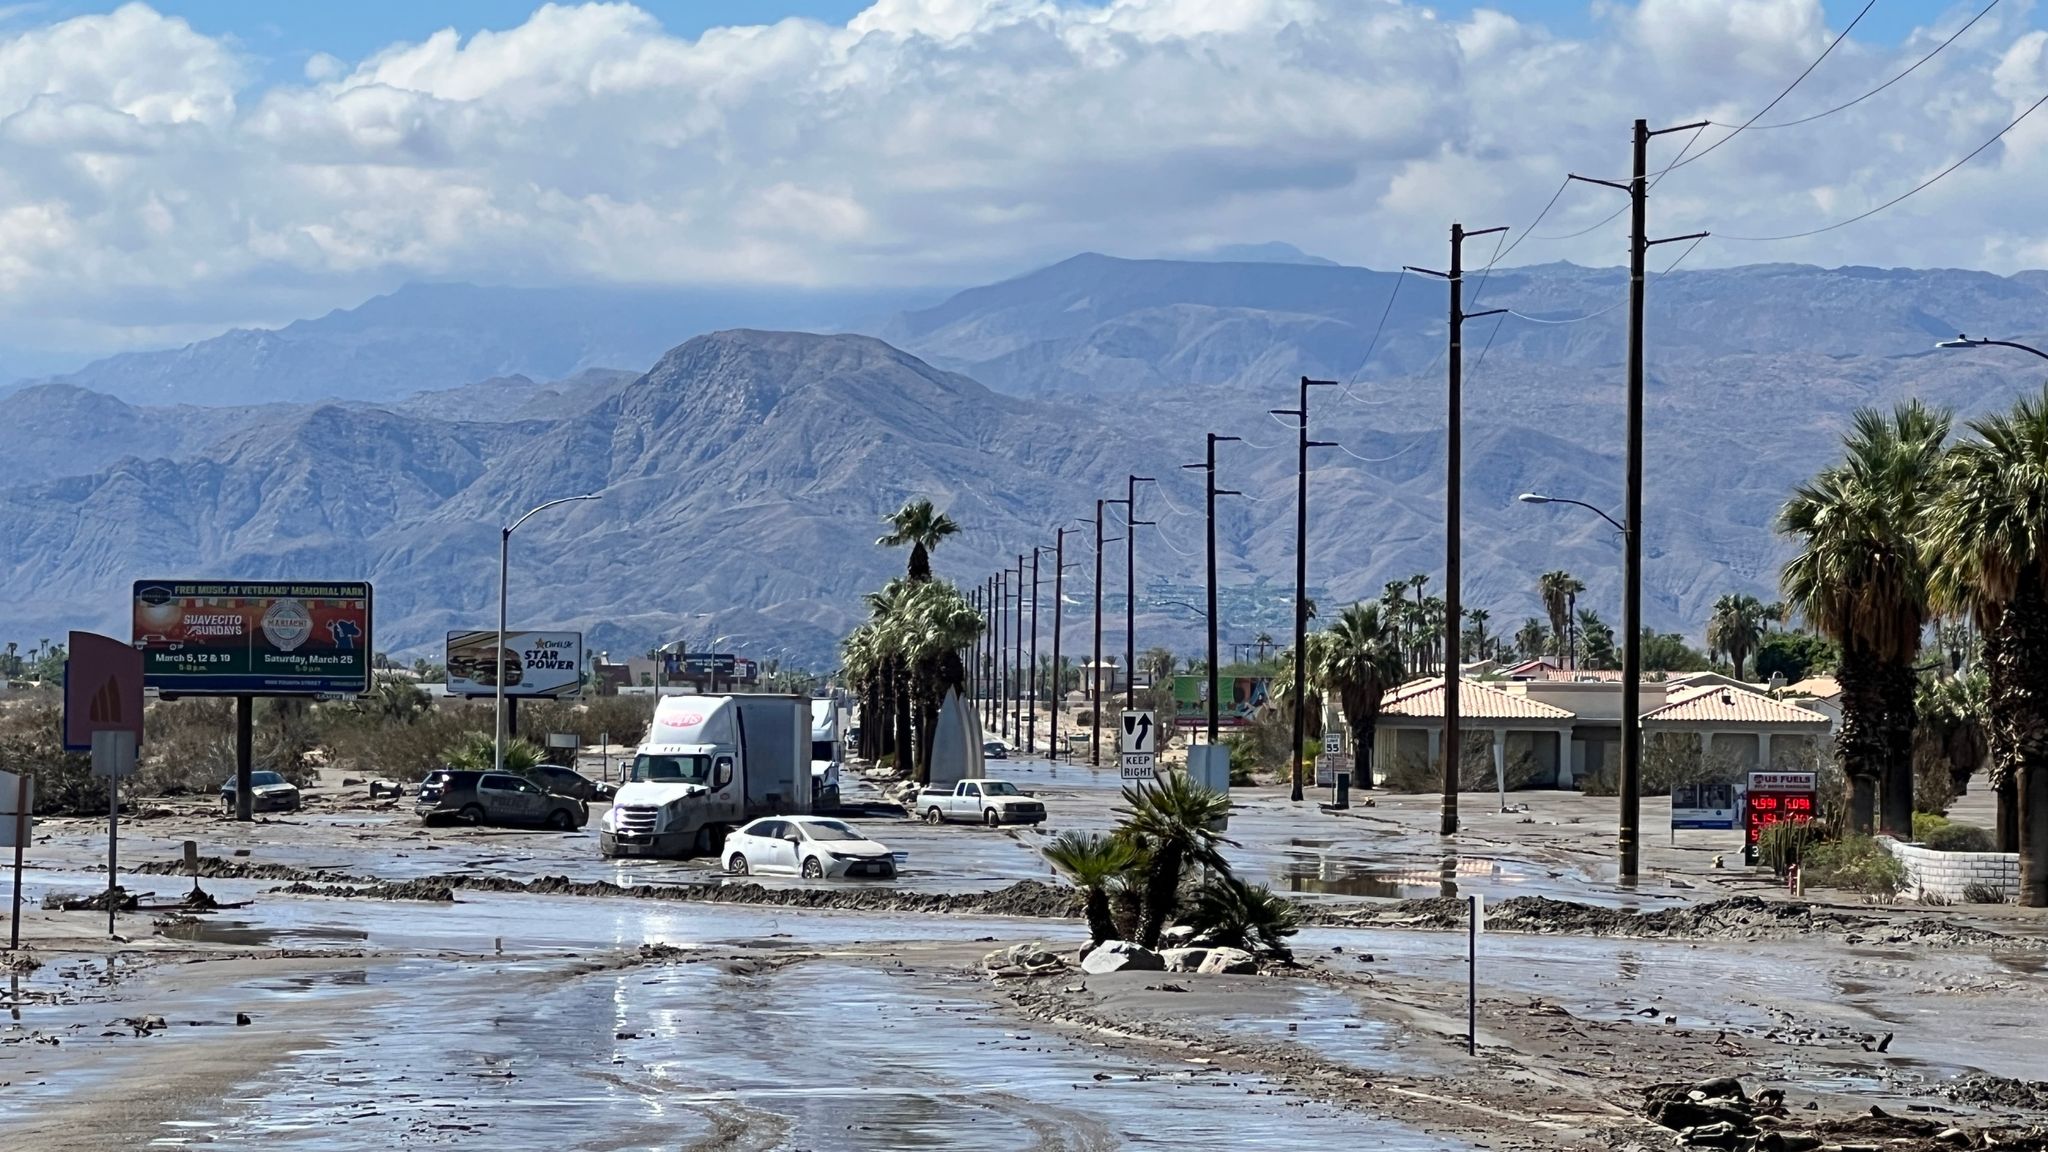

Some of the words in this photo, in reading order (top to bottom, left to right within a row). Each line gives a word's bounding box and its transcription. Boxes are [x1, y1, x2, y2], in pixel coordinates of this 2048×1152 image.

[174, 585, 195, 595] FREE
[197, 585, 227, 595] MUSIC
[228, 586, 239, 595] AT
[291, 586, 339, 596] MEMORIAL
[340, 587, 364, 596] PARK
[183, 614, 242, 625] SUAVECITO
[267, 619, 307, 627] MARIACHI
[195, 625, 242, 635] SUNDAYS
[155, 653, 185, 662] March
[198, 654, 208, 662] 12
[209, 654, 218, 662] &
[220, 654, 231, 662] 19
[264, 654, 308, 665] Saturday,
[309, 655, 339, 664] March
[340, 655, 354, 664] 25
[524, 650, 559, 660] STAR
[526, 660, 574, 670] POWER
[1326, 743, 1339, 752] 55
[1126, 755, 1150, 765] KEEP
[1124, 767, 1152, 777] RIGHT
[1765, 775, 1778, 783] US
[1780, 775, 1811, 783] FUELS
